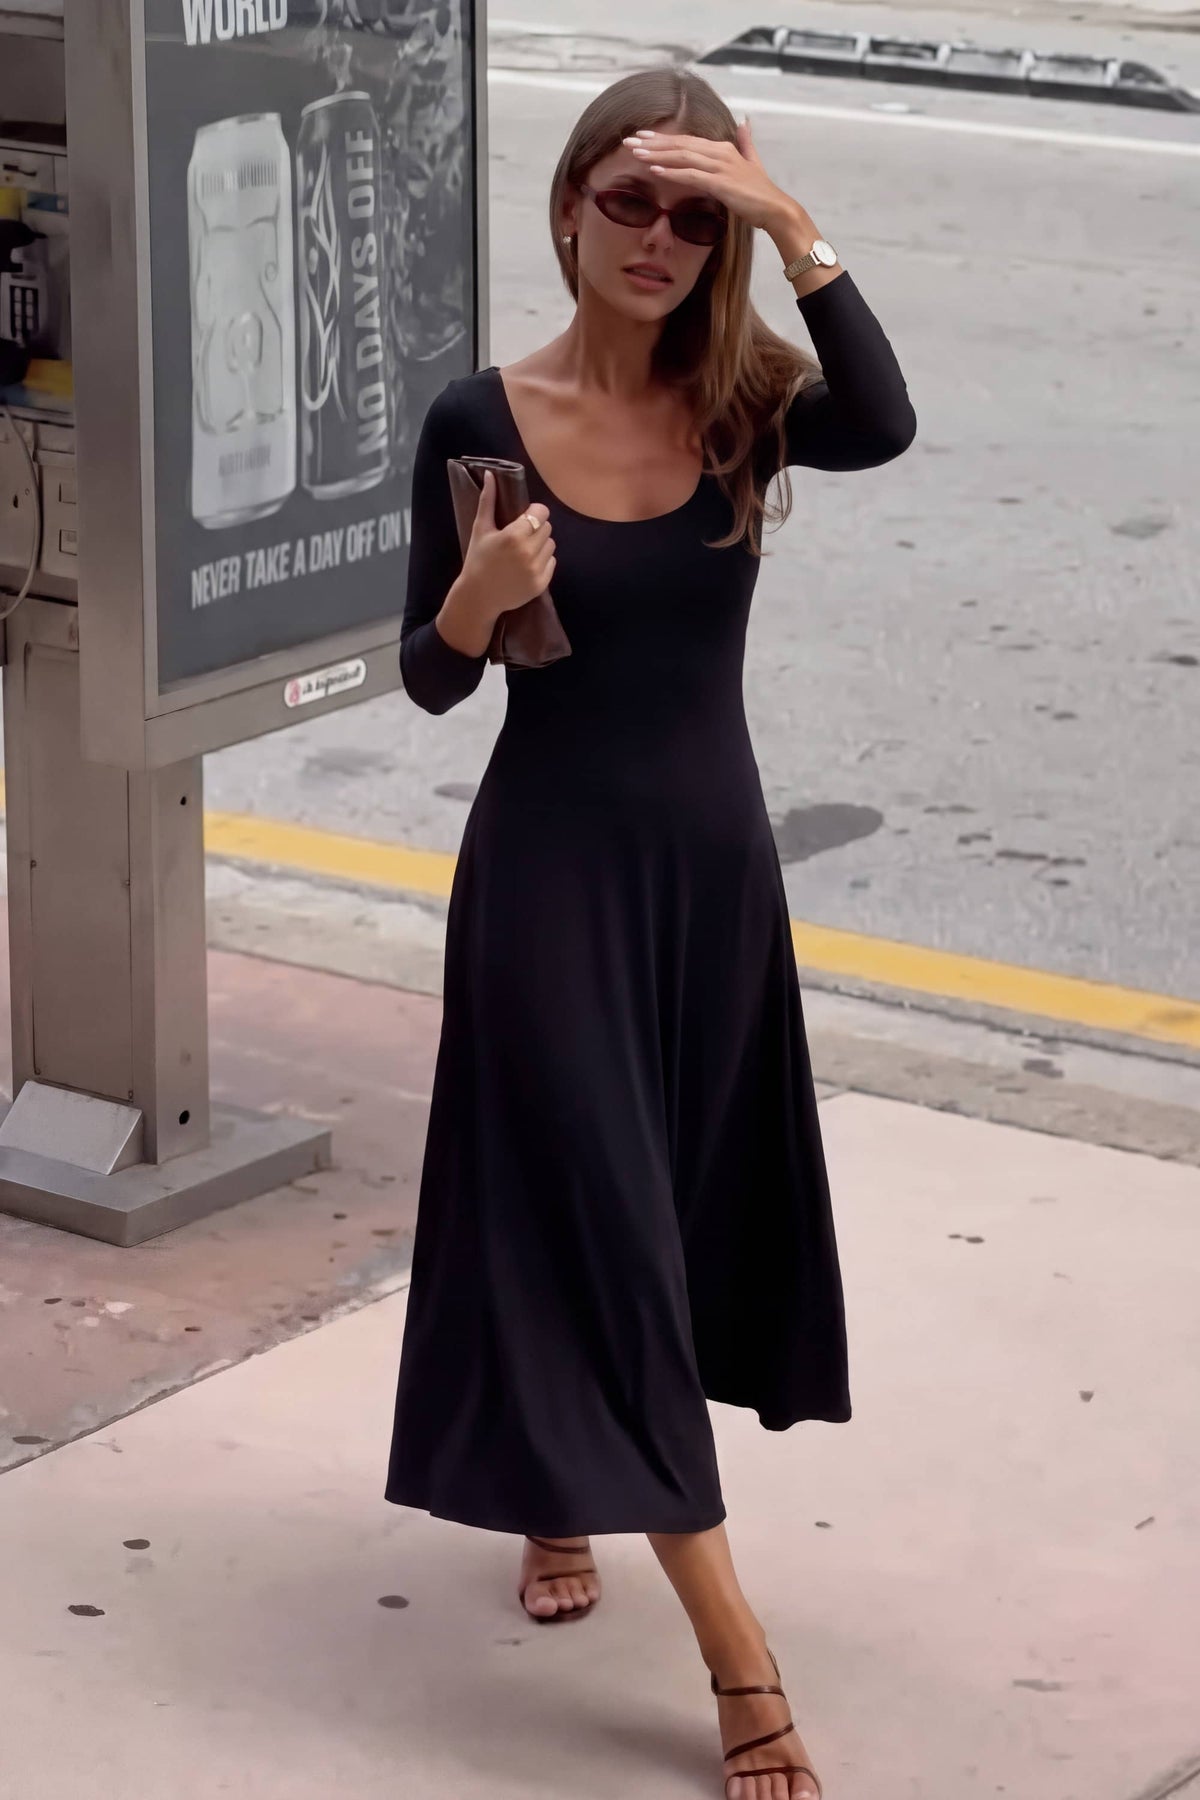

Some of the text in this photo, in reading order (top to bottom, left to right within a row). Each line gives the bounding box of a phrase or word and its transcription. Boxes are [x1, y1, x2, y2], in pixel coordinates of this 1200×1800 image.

[182, 0, 288, 46] WORLD
[344, 130, 388, 457] NO DAYS OFF
[191, 555, 241, 610] NEVER
[245, 541, 290, 589] TAKE
[293, 538, 306, 578] A
[309, 528, 344, 573] DAY
[346, 518, 376, 563] OFF
[378, 511, 401, 553] ON
